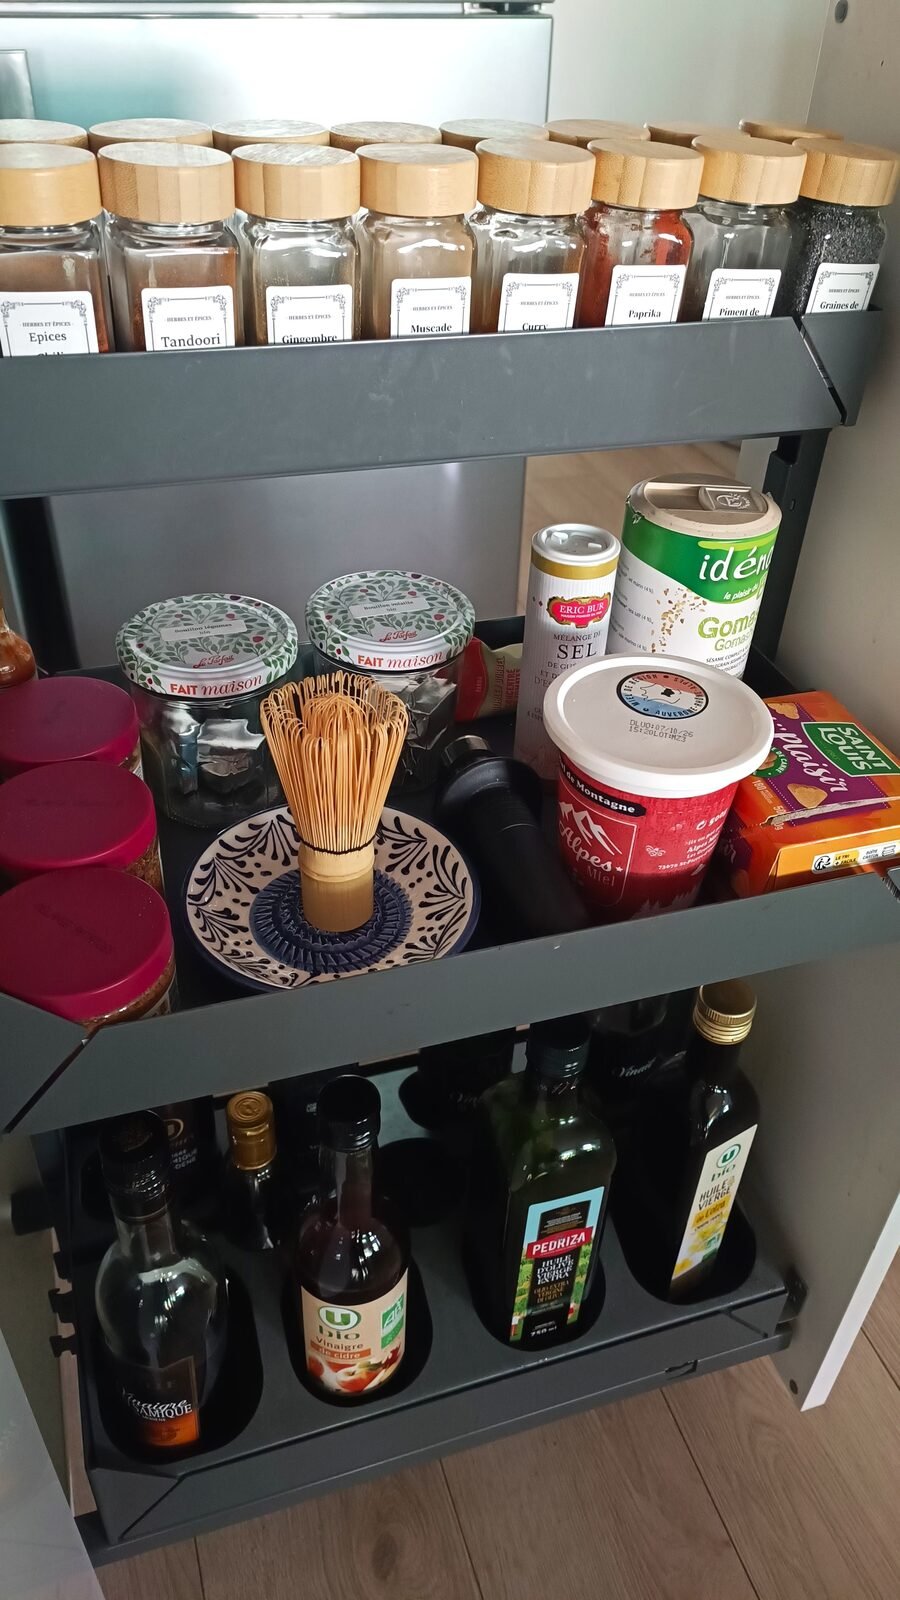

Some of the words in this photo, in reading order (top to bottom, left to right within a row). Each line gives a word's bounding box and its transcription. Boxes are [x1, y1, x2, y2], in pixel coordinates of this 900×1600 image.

[719, 308, 748, 316] Piment
[749, 307, 760, 316] de
[820, 301, 849, 310] Graines
[849, 301, 859, 310] de
[628, 309, 661, 320] Paprika
[410, 323, 452, 333] Muscade
[522, 322, 548, 331] Curry
[29, 331, 67, 344] Epices
[160, 333, 221, 348] Tandoori
[282, 333, 338, 344] Gingembre
[724, 592, 731, 600] le
[560, 605, 585, 614] ERIC
[587, 602, 604, 613] BUR
[357, 655, 384, 667] FAIT
[387, 650, 443, 668] maison
[557, 643, 597, 660] SEL
[547, 661, 558, 669] DE
[170, 683, 198, 696] FAIT
[202, 674, 262, 696] maison
[623, 684, 633, 692] DE
[625, 694, 640, 707] MIEL
[818, 727, 872, 771] LOUIS
[837, 727, 892, 770] SAINT
[566, 770, 577, 783] de
[576, 780, 636, 813] Montagne
[560, 821, 612, 872] Alpes
[587, 865, 615, 887] Miel
[700, 1179, 728, 1202] HUILE
[698, 1187, 731, 1210] VIERGE
[532, 1231, 586, 1256] PEDRIZA
[542, 1254, 572, 1268] HUILE
[325, 1309, 350, 1326] U
[319, 1325, 360, 1340] bio
[315, 1336, 363, 1351] Vinaigre
[320, 1348, 331, 1356] de
[334, 1350, 361, 1360] cidre
